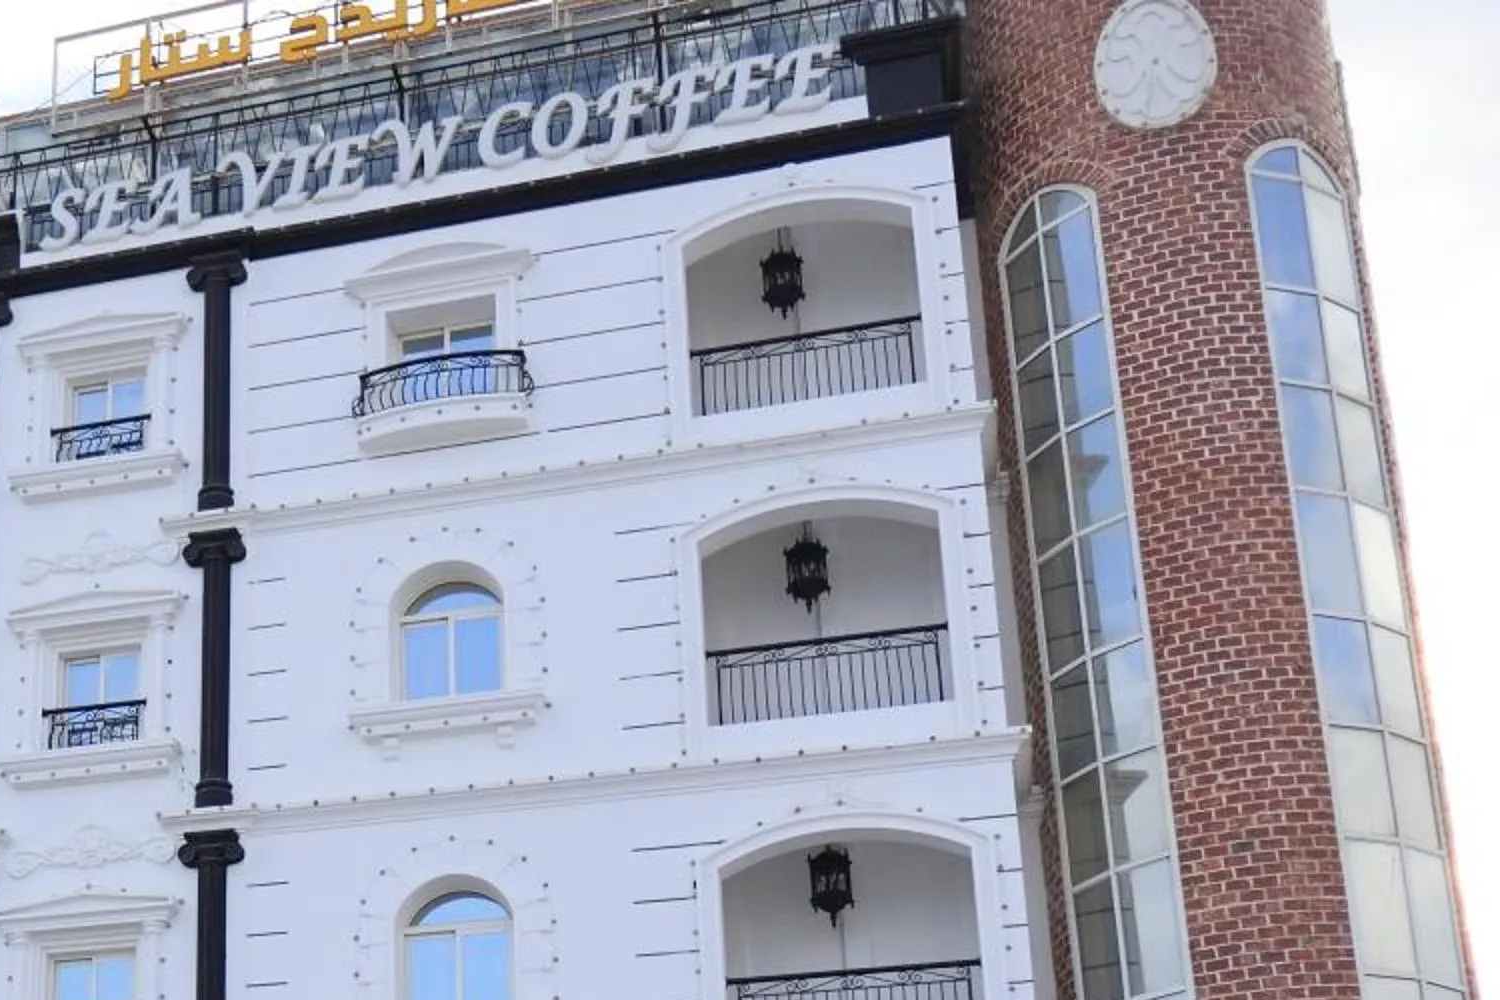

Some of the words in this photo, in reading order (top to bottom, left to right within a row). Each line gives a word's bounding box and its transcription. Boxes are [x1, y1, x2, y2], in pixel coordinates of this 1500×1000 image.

[108, 26, 252, 101] ستار
[38, 165, 200, 250] SEA
[214, 114, 464, 219] VIEW
[476, 42, 840, 168] COFFEE
